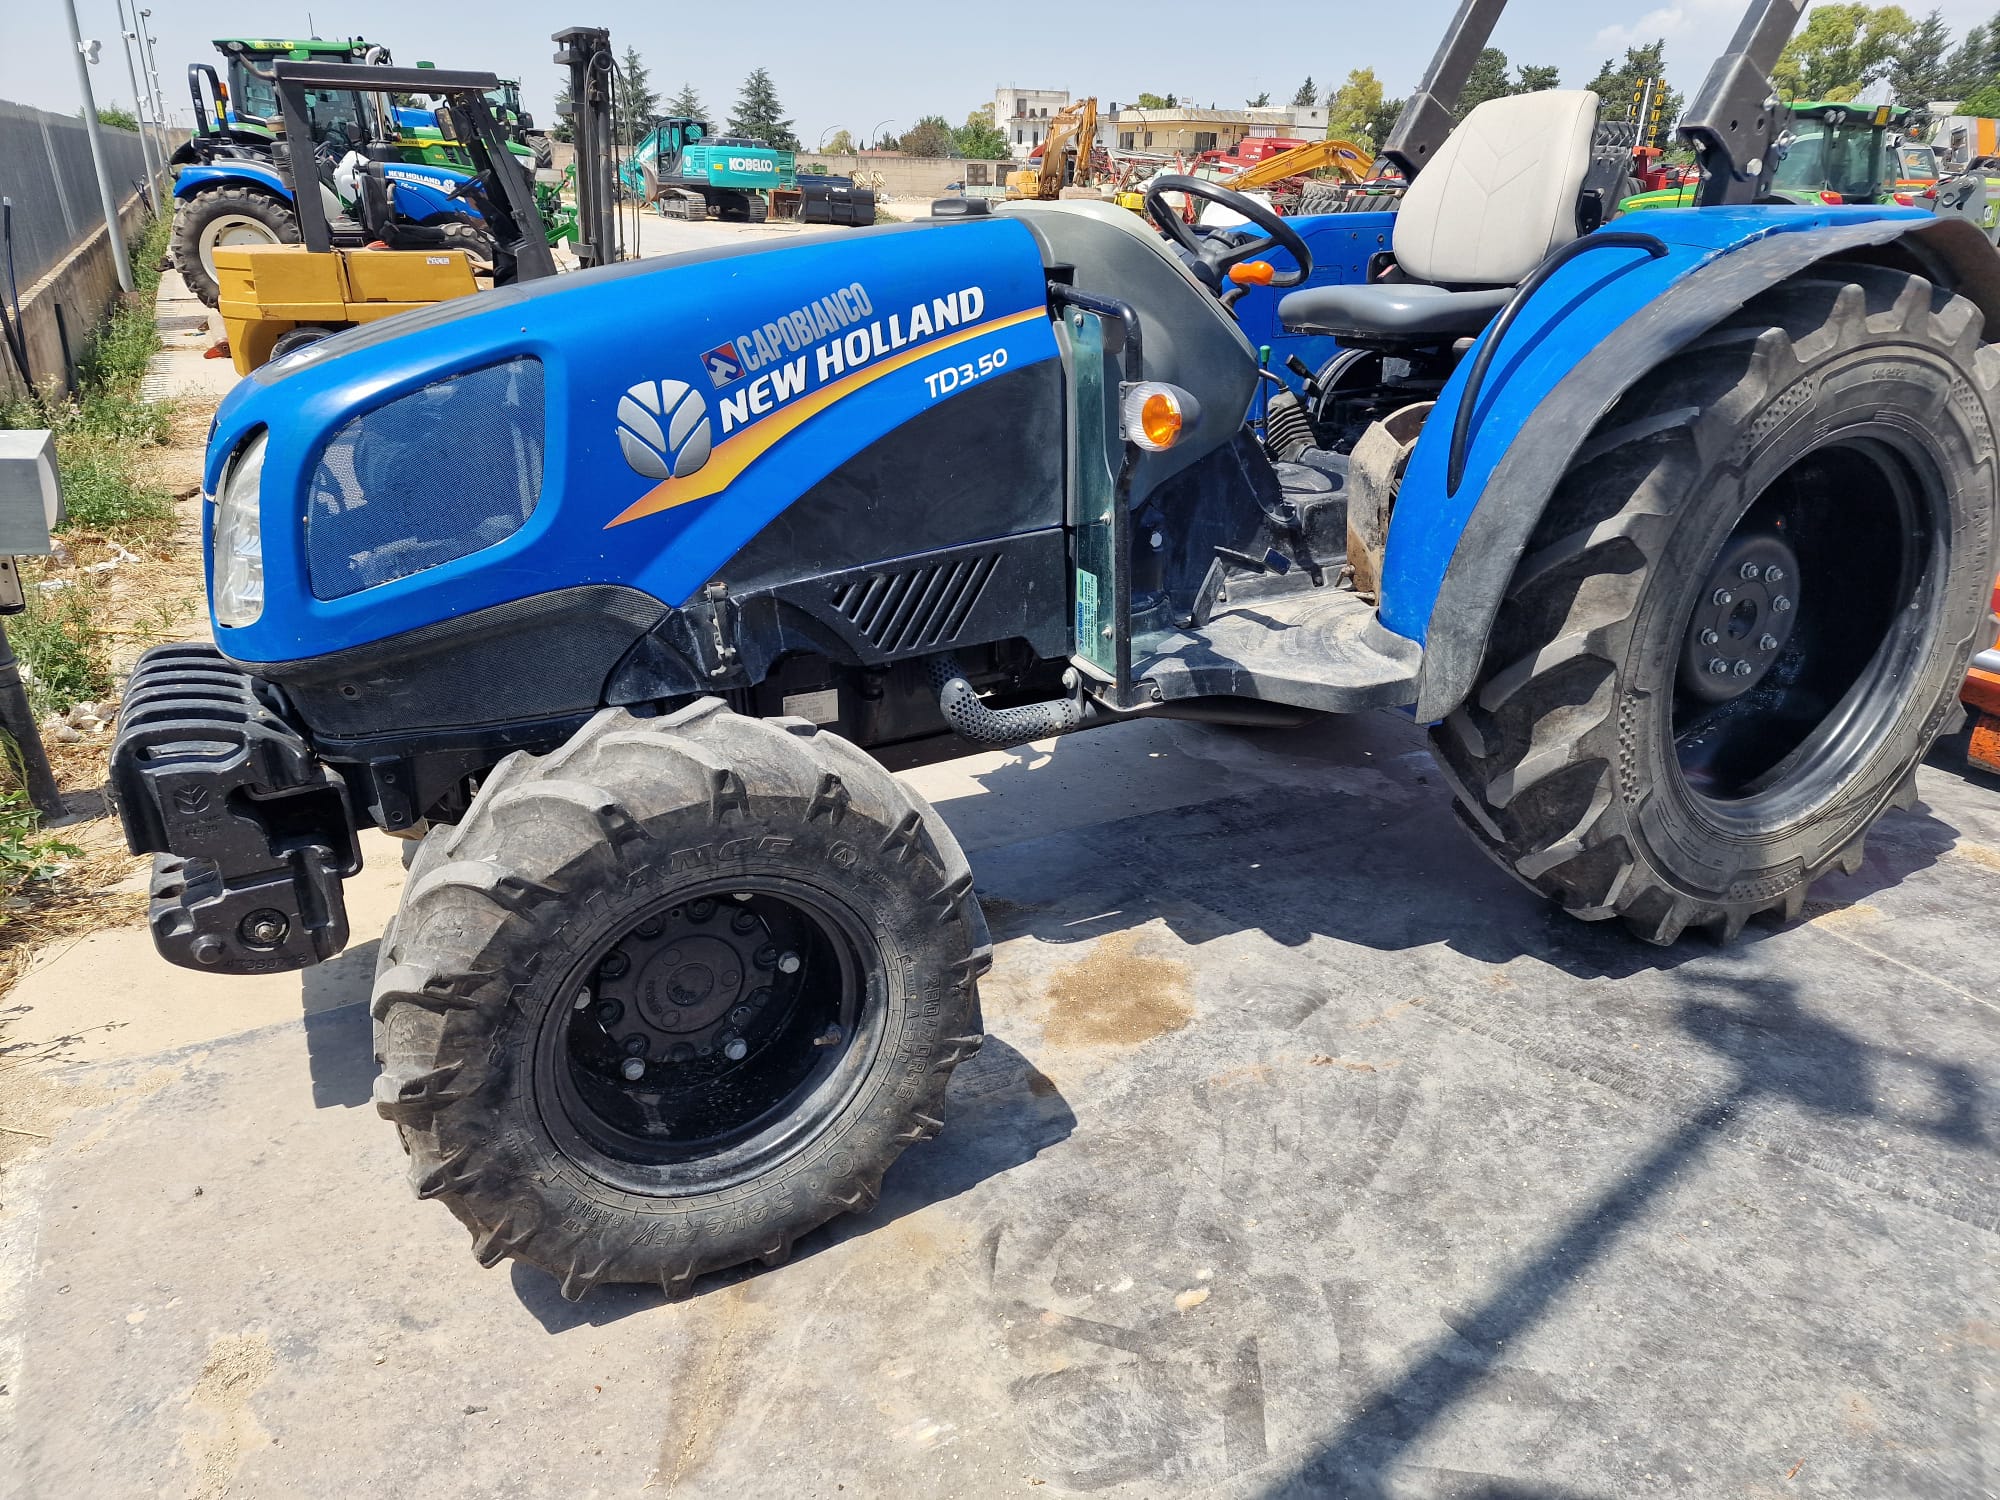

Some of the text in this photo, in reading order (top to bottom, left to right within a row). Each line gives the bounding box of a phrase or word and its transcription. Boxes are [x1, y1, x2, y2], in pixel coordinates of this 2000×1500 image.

[406, 172, 441, 185] HOLLAND
[729, 157, 772, 172] KOBELCO
[735, 282, 873, 372] CAPOBIANCO
[719, 286, 985, 433] NEW HOLLAND
[924, 348, 1008, 399] TD3.50
[567, 1192, 627, 1229] RADIAL
